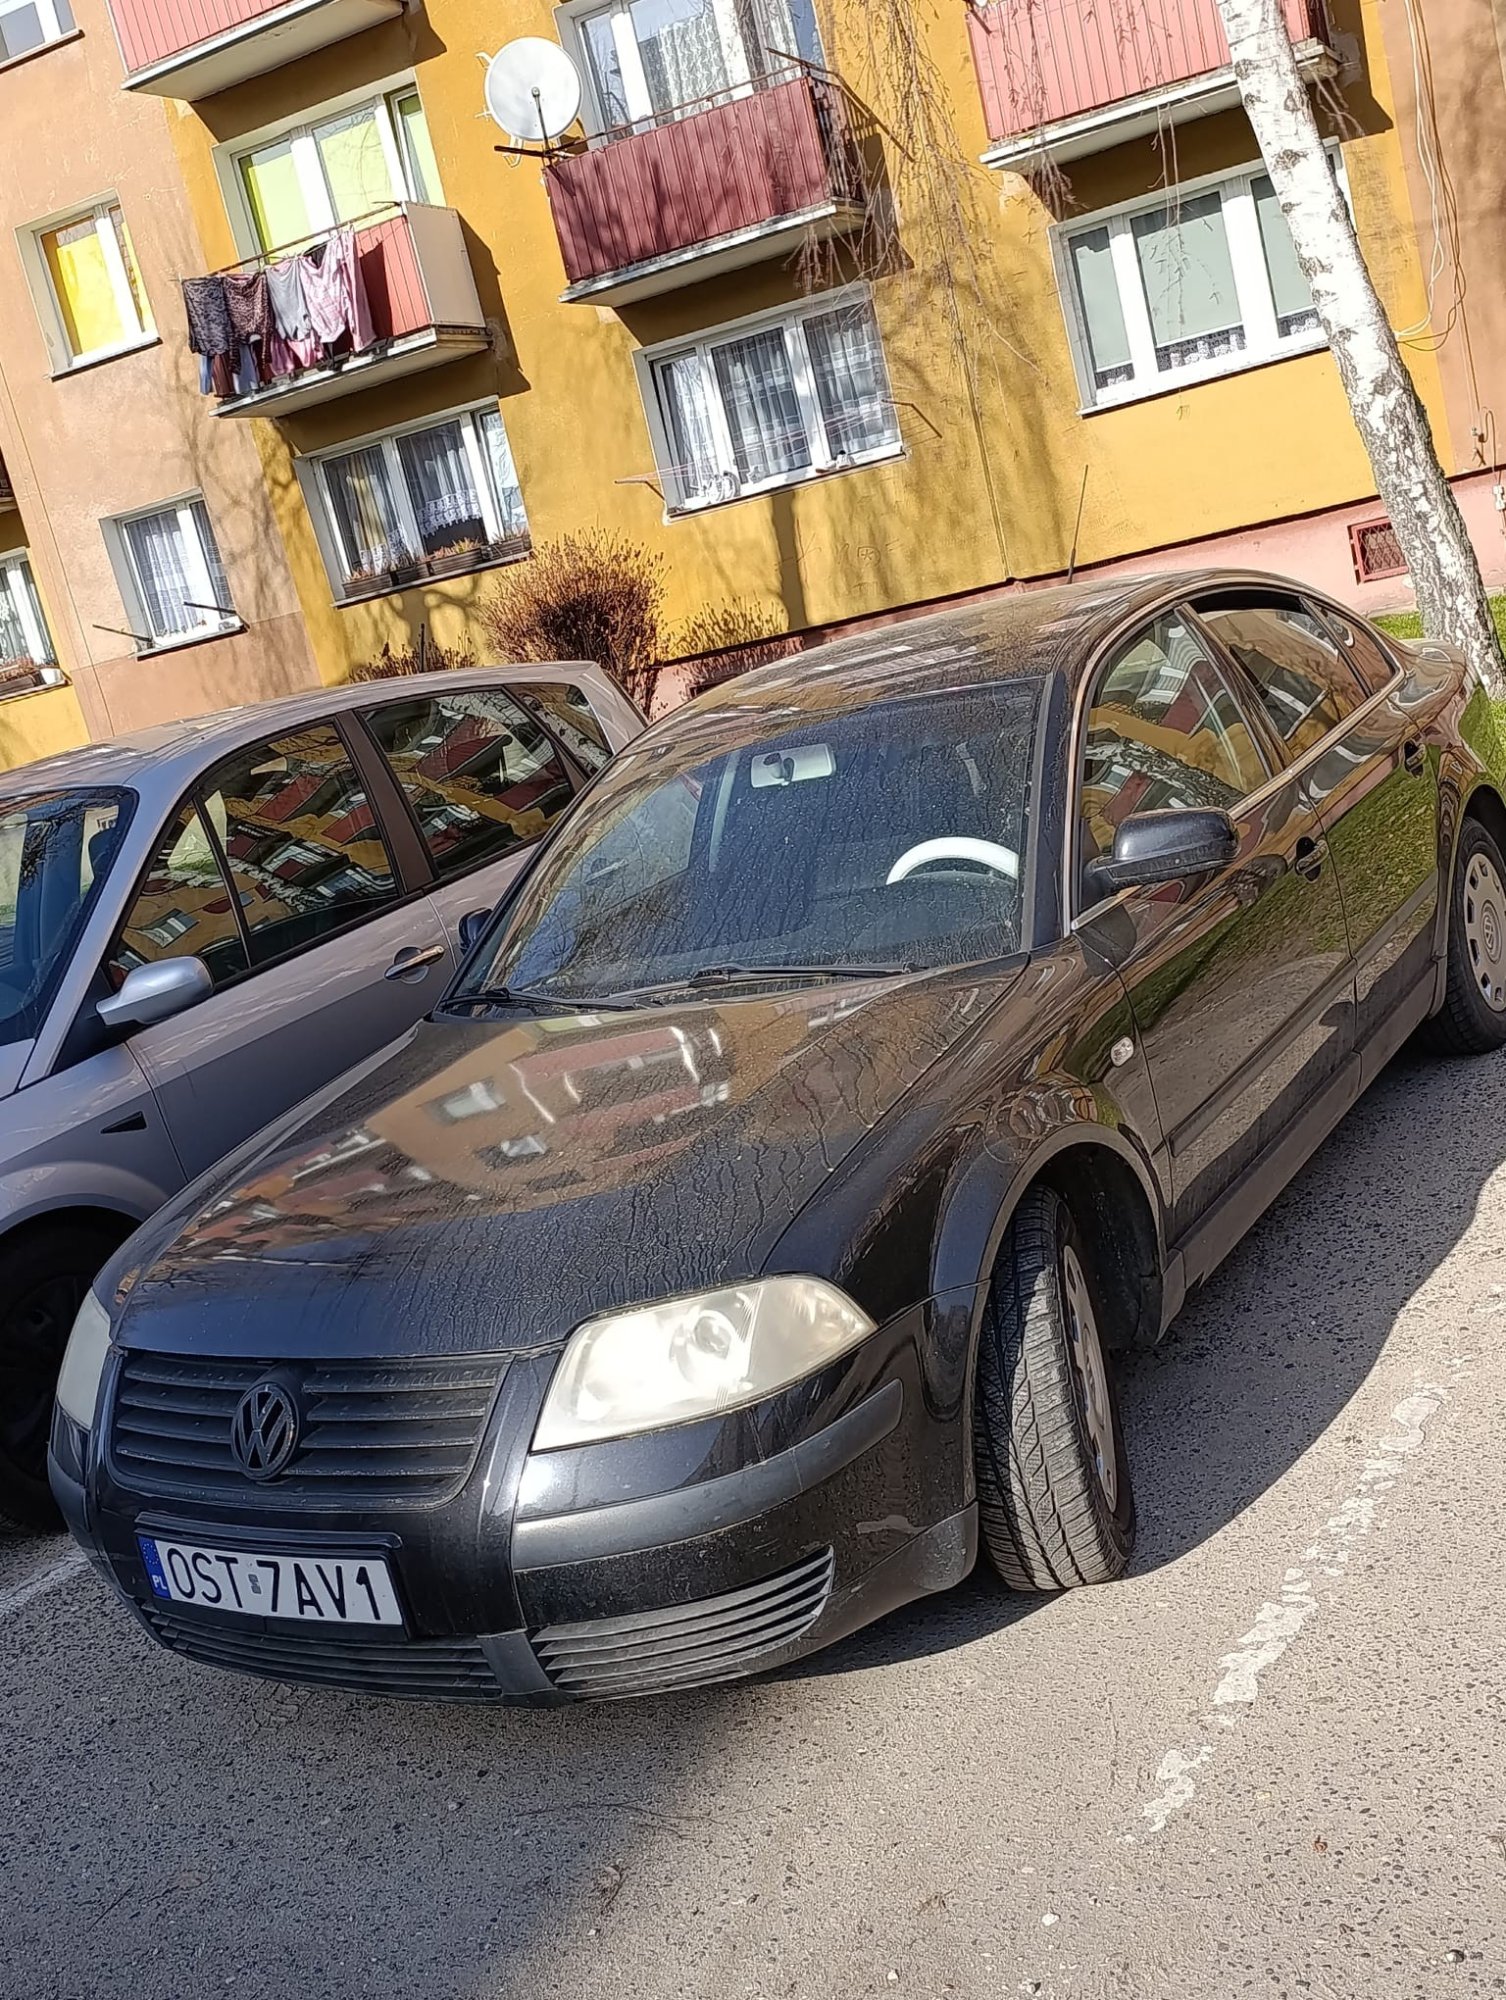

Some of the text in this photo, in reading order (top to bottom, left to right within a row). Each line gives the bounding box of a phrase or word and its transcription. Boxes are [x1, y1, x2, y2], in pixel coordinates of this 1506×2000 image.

[236, 1386, 292, 1475] VW
[152, 1575, 168, 1591] PL
[167, 1547, 381, 1620] OST 7AV1
